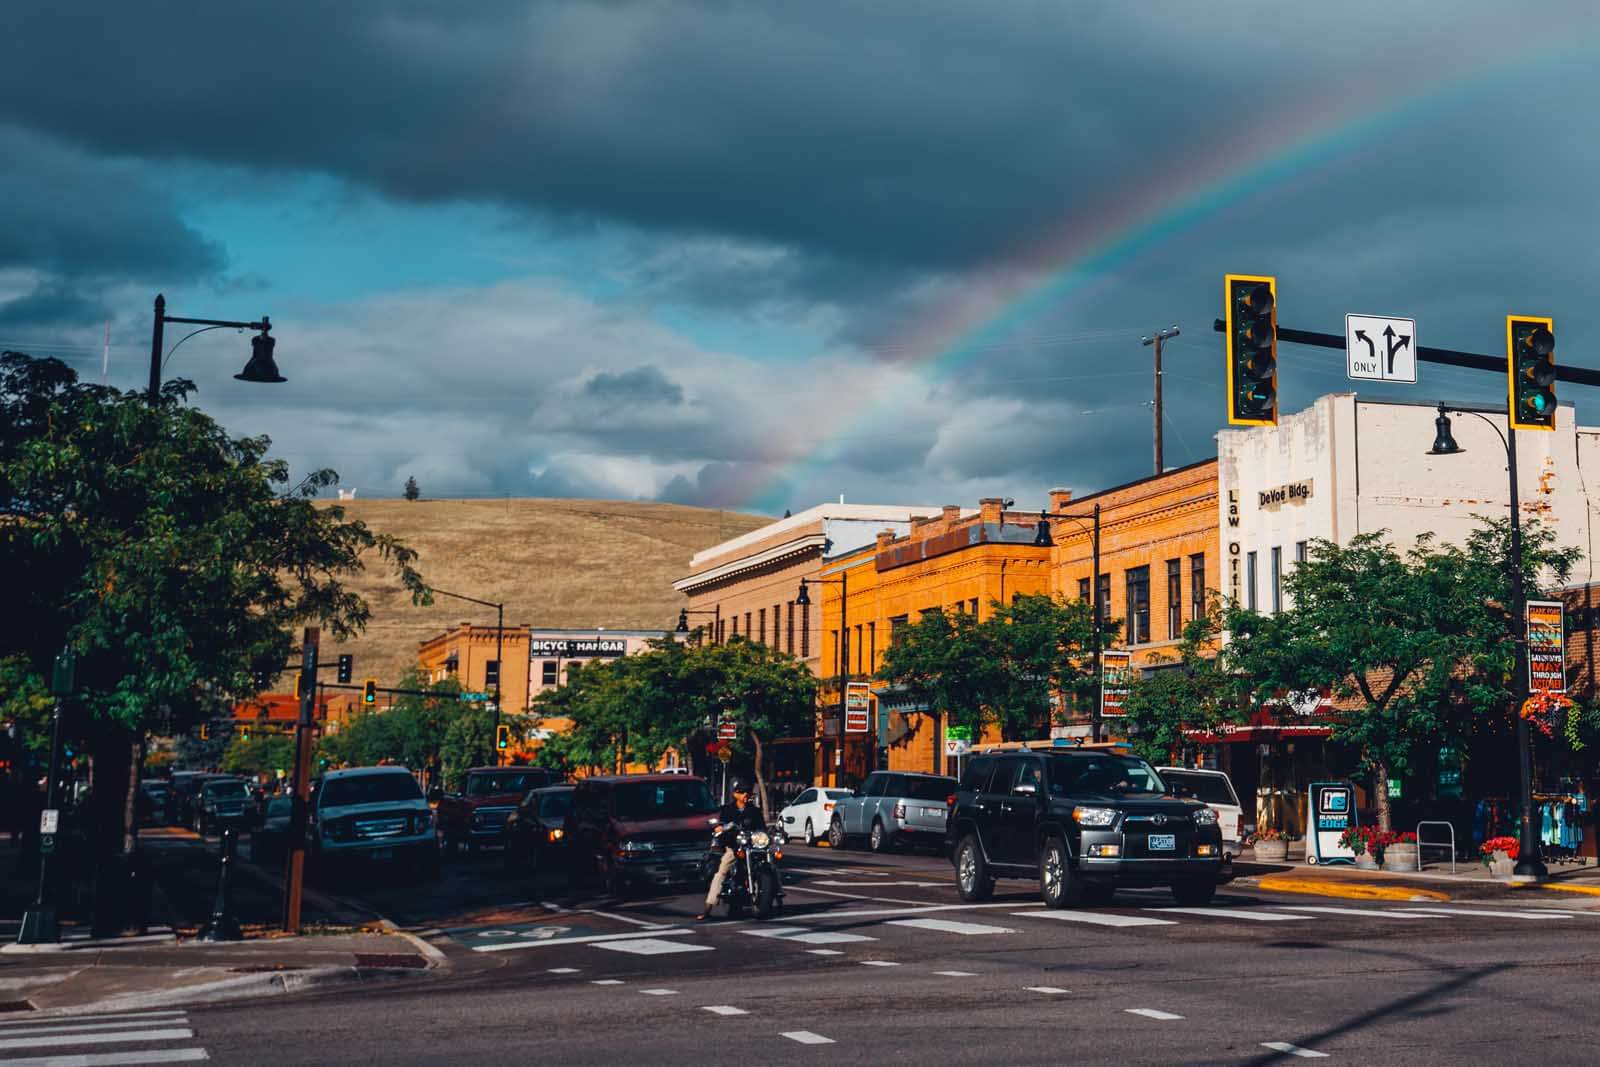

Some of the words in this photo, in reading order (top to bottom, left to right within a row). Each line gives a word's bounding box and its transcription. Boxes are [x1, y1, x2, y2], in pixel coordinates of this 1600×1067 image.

[1353, 361, 1377, 373] ONLY
[1288, 482, 1310, 499] Bldg.
[1228, 489, 1240, 528] Law
[533, 640, 572, 651] BICYCL
[1532, 662, 1562, 672] MAY
[1318, 820, 1348, 829] EDGE
